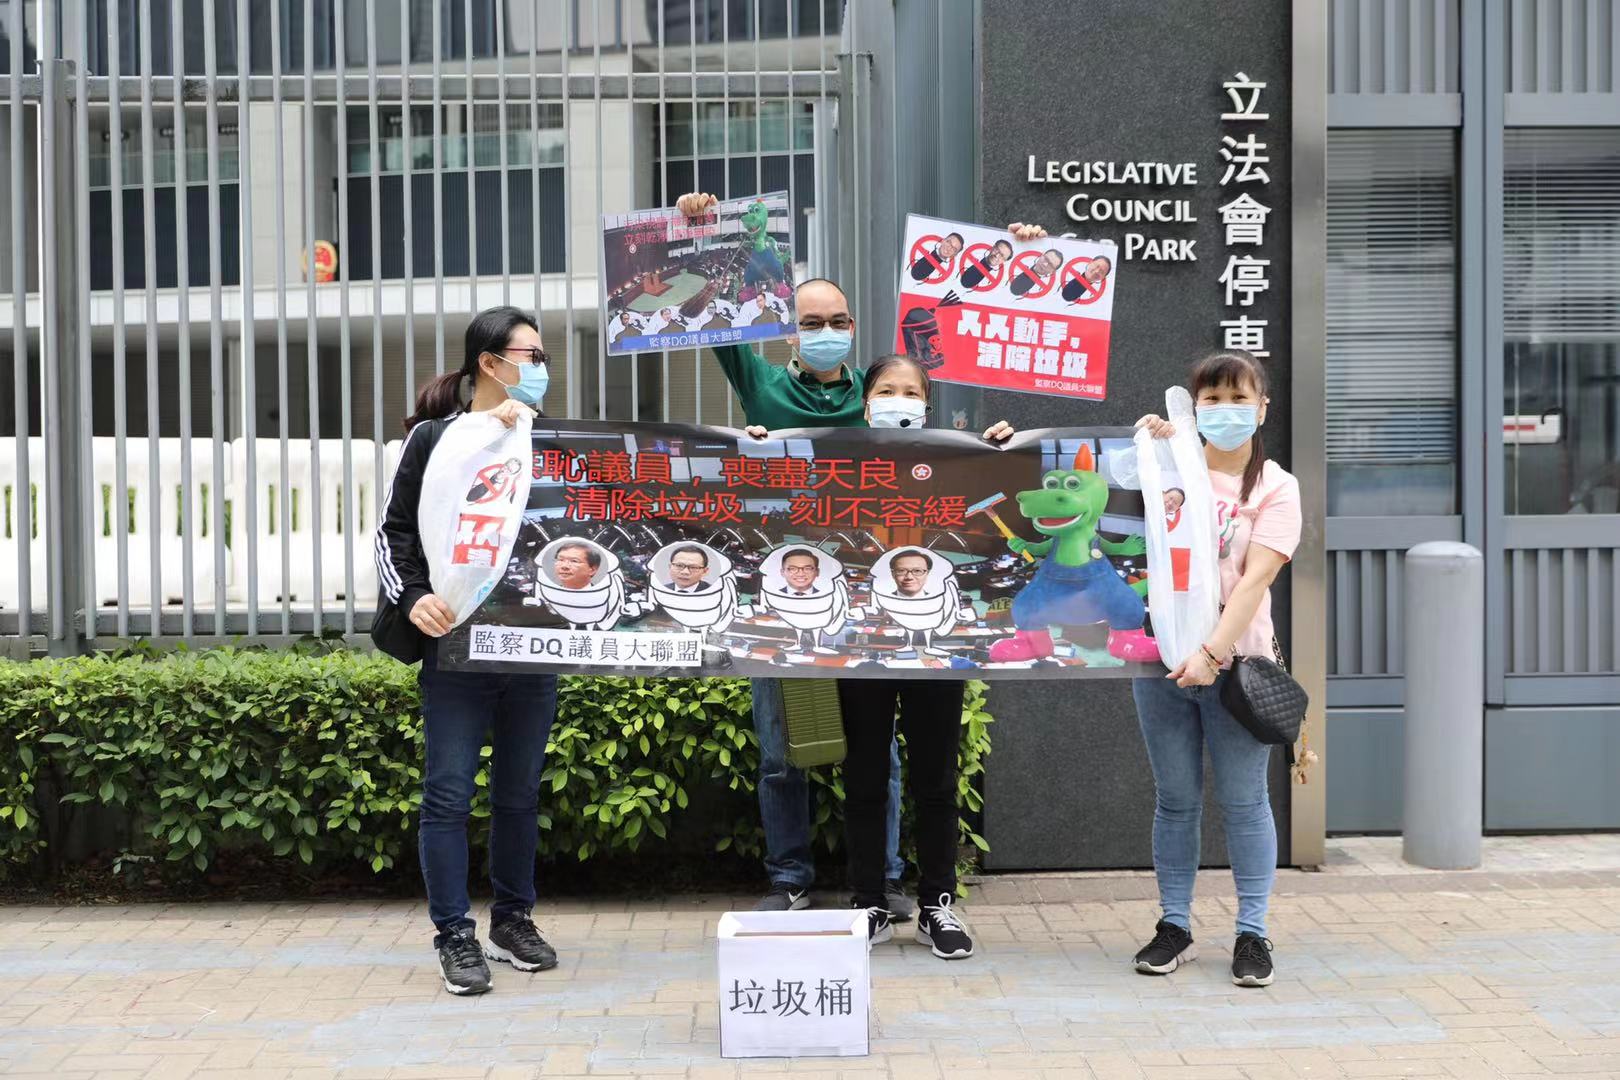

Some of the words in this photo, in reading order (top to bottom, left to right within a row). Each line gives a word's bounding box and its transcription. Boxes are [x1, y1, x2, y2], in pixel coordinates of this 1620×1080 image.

[1027, 155, 1198, 186] LEGISLATIVE
[1066, 193, 1198, 223] COUNCIL
[1124, 233, 1198, 262] PARK
[649, 330, 743, 348] 監察DQ議員大聯盟
[976, 341, 1089, 379] 清除垃圾
[564, 486, 968, 528] 清除垃圾，刻不容緩
[473, 630, 699, 662] 監察DQ議員大聯盟
[729, 978, 853, 1017] 垃圾桶
